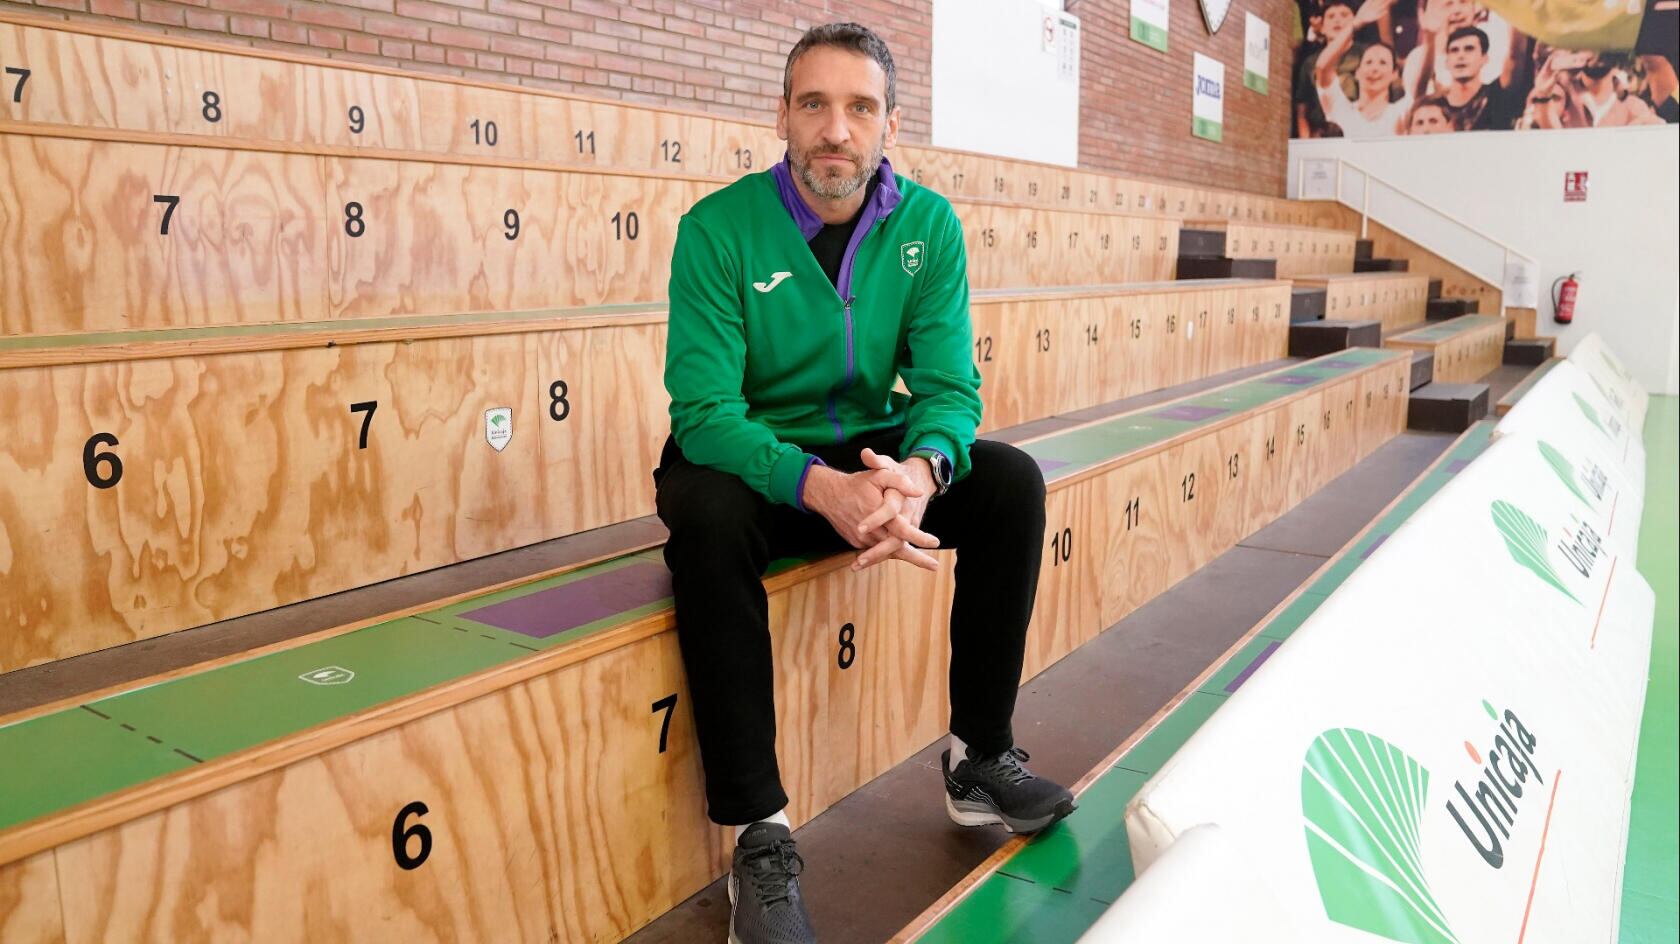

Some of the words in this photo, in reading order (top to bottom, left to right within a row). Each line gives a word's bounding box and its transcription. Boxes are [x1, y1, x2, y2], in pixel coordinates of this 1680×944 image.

[5, 66, 31, 103] 7
[202, 90, 222, 123] 8
[348, 105, 365, 134] 9
[470, 119, 498, 147] 10
[574, 130, 596, 155] 11
[661, 139, 681, 163] 12
[735, 148, 752, 170] 13
[953, 174, 964, 190] 17
[153, 194, 180, 236] 7
[344, 201, 366, 238] 8
[503, 208, 520, 241] 9
[611, 211, 639, 241] 10
[982, 229, 995, 248] 15
[1026, 231, 1037, 249] 16
[1069, 232, 1078, 249] 17
[1130, 319, 1141, 339] 15
[1166, 315, 1176, 334] 16
[1200, 311, 1207, 329] 17
[1036, 329, 1050, 352] 13
[1086, 323, 1098, 346] 14
[975, 336, 993, 362] 12
[549, 380, 570, 422] 8
[350, 400, 378, 450] 7
[1323, 410, 1330, 430] 16
[1266, 435, 1275, 461] 14
[1297, 424, 1305, 446] 15
[82, 432, 123, 490] 6
[1228, 453, 1239, 480] 13
[1182, 473, 1195, 503] 12
[1126, 497, 1140, 531] 11
[1051, 527, 1072, 567] 10
[1558, 513, 1608, 579] Unicaja
[837, 622, 856, 670] 8
[651, 692, 678, 754] 7
[1446, 699, 1544, 869] Unicaja
[391, 801, 433, 871] 6
